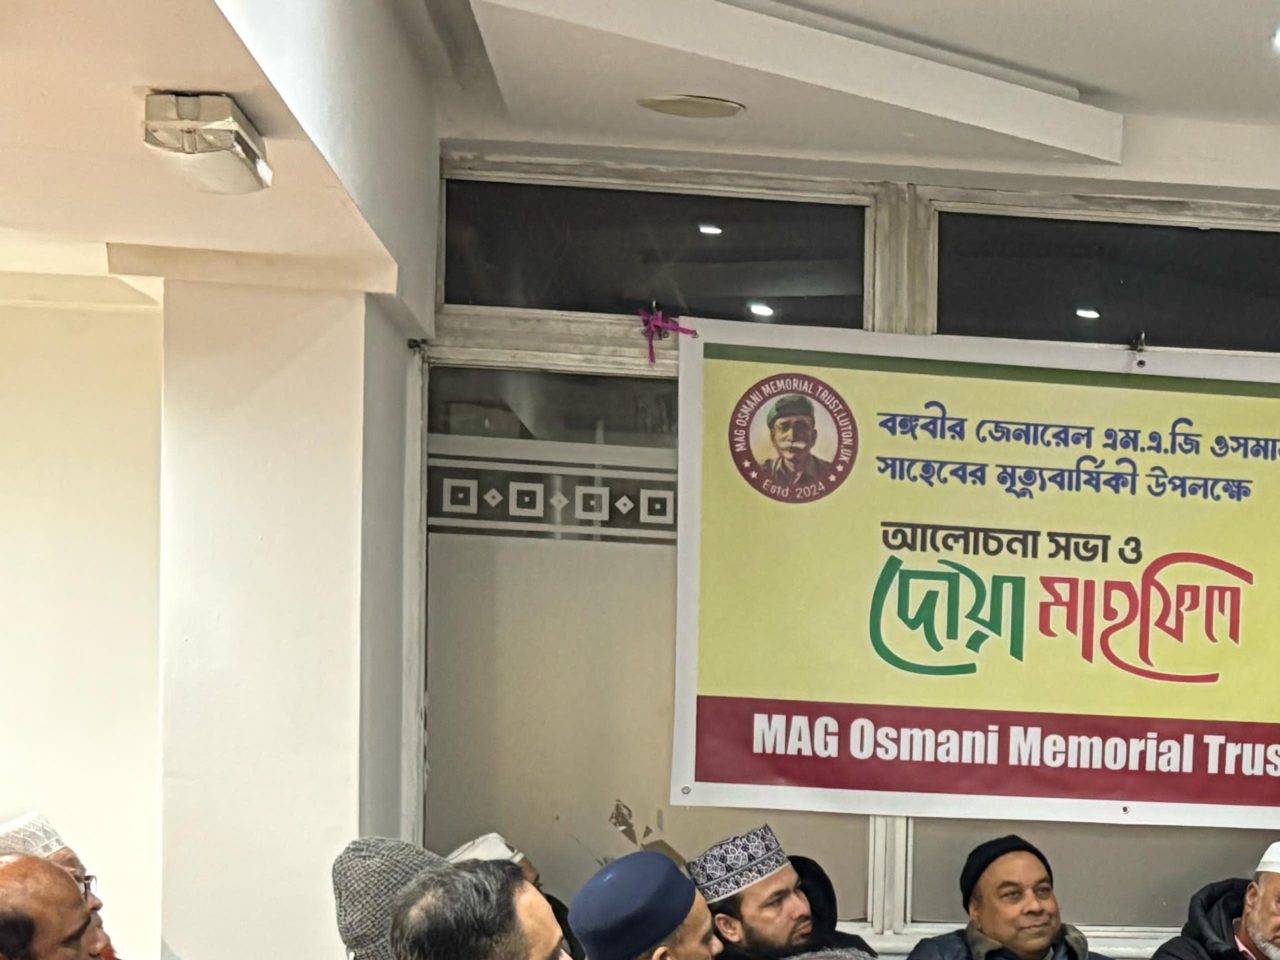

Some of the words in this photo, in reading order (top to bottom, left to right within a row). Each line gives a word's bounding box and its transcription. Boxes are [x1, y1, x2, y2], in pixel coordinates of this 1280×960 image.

[736, 391, 764, 425] OSMANI
[761, 378, 813, 397] MEMORIAL
[734, 430, 746, 452] MAG
[876, 400, 967, 440] বঙ্গবীর
[975, 419, 1095, 449] জেনারেল
[1102, 417, 1202, 455] এম.এ.জি
[795, 481, 826, 499] 2024
[876, 456, 989, 487] সাহেবের
[995, 455, 1139, 499] মৃত্যুবার্ষিকী
[1145, 466, 1253, 501] উপলক্ষে
[880, 521, 1041, 559] আলোচনা
[1047, 532, 1111, 563] সভা
[1118, 536, 1143, 565] ও
[869, 555, 1026, 675] দোয়া
[1038, 551, 1254, 683] মাহফিল
[753, 713, 839, 758] MAG
[850, 718, 999, 765] Osmani
[1008, 726, 1195, 774] Memorial
